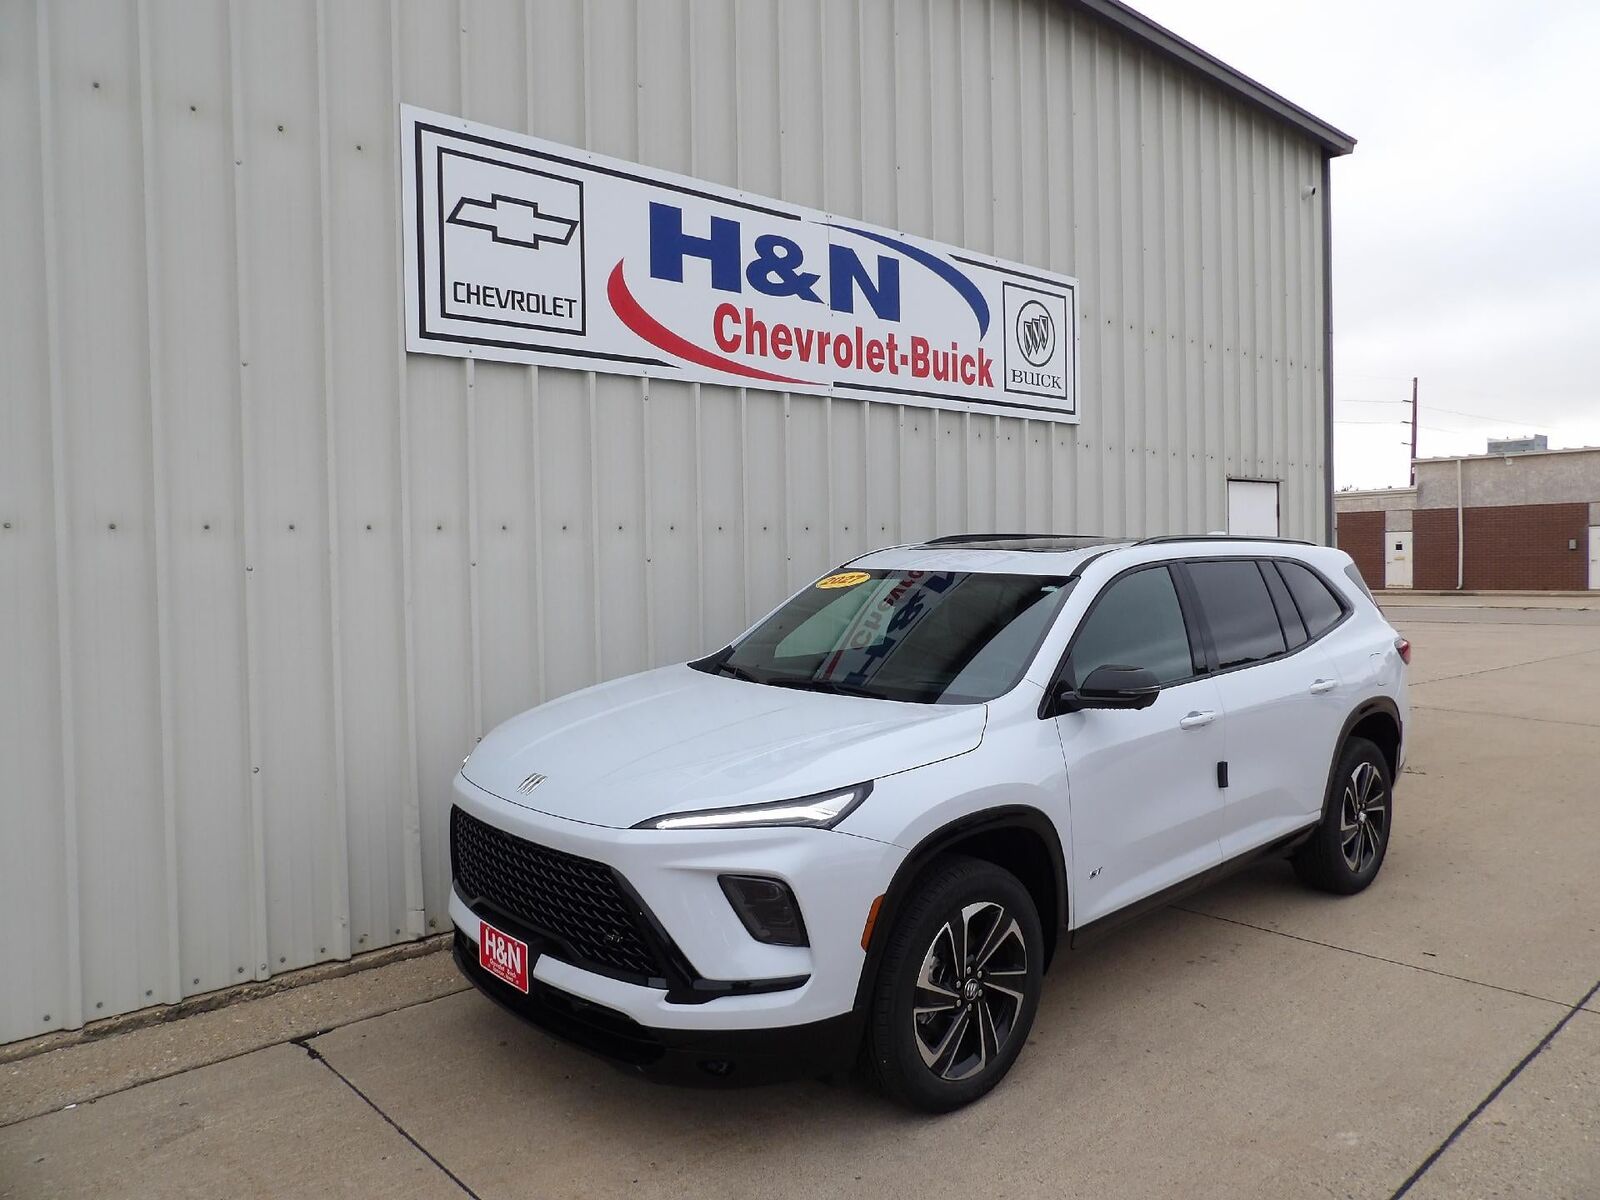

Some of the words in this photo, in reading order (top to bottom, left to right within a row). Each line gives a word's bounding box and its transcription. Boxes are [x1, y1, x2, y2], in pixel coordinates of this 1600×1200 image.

[649, 201, 901, 323] H&N
[453, 281, 577, 319] CHEVROLET
[1011, 369, 1062, 390] BUICK
[485, 928, 521, 975] H&N
